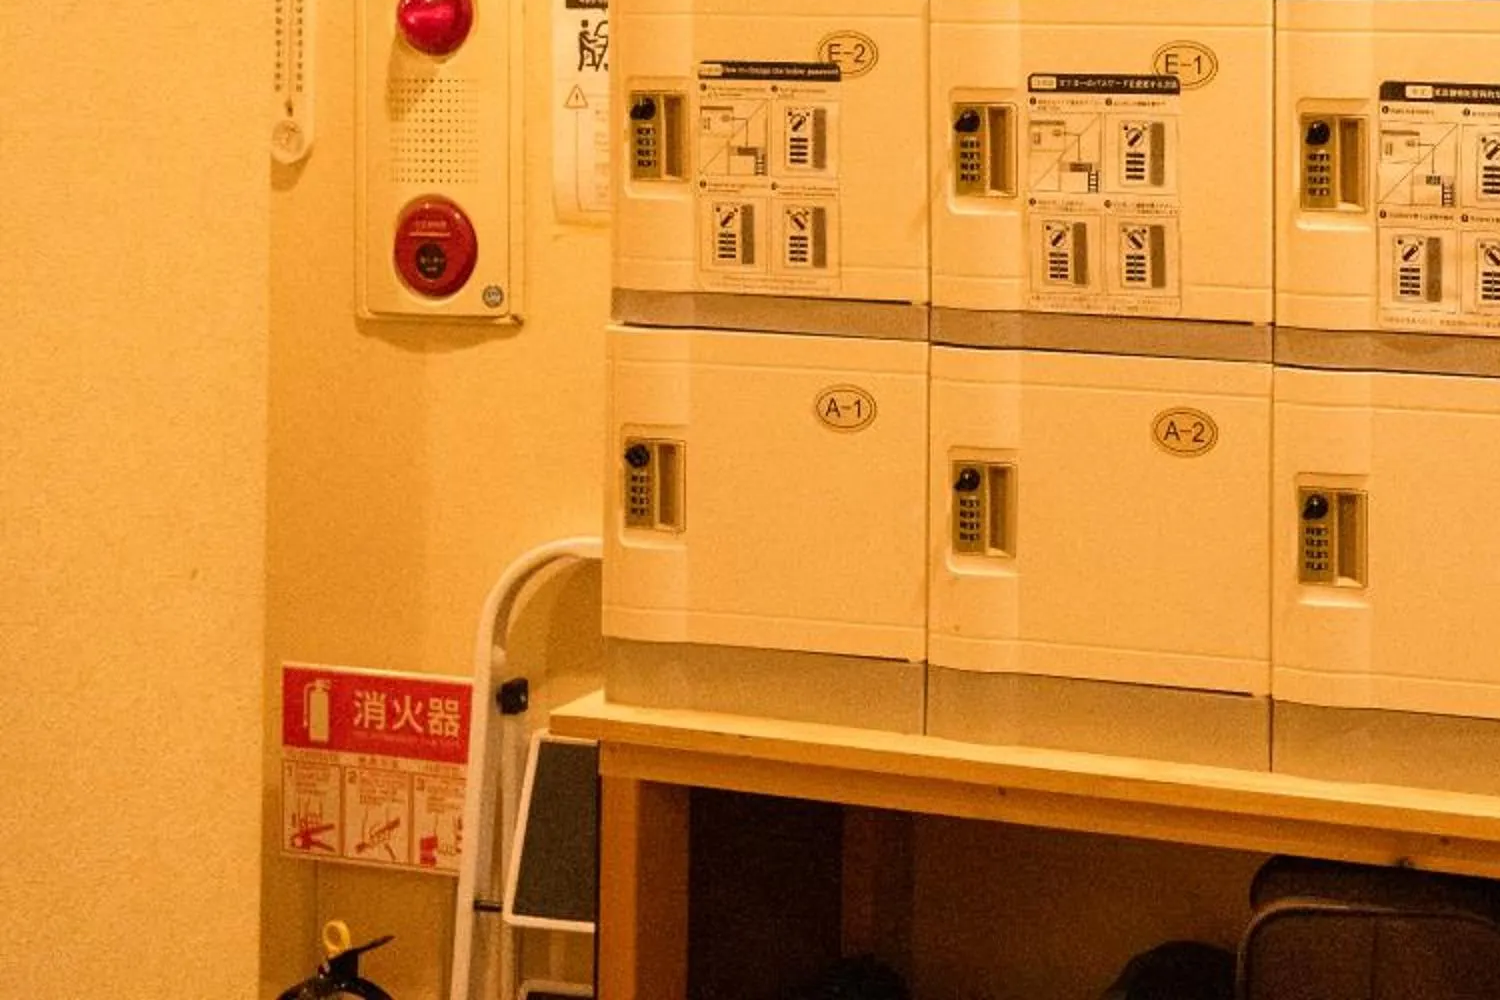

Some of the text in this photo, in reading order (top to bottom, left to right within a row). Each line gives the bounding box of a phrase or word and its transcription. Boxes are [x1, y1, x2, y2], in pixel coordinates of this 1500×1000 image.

[828, 44, 866, 63] E-2
[1165, 54, 1202, 75] E-1
[825, 398, 862, 420] A-1
[1163, 420, 1206, 443] A-2
[352, 690, 461, 737] 消火器
